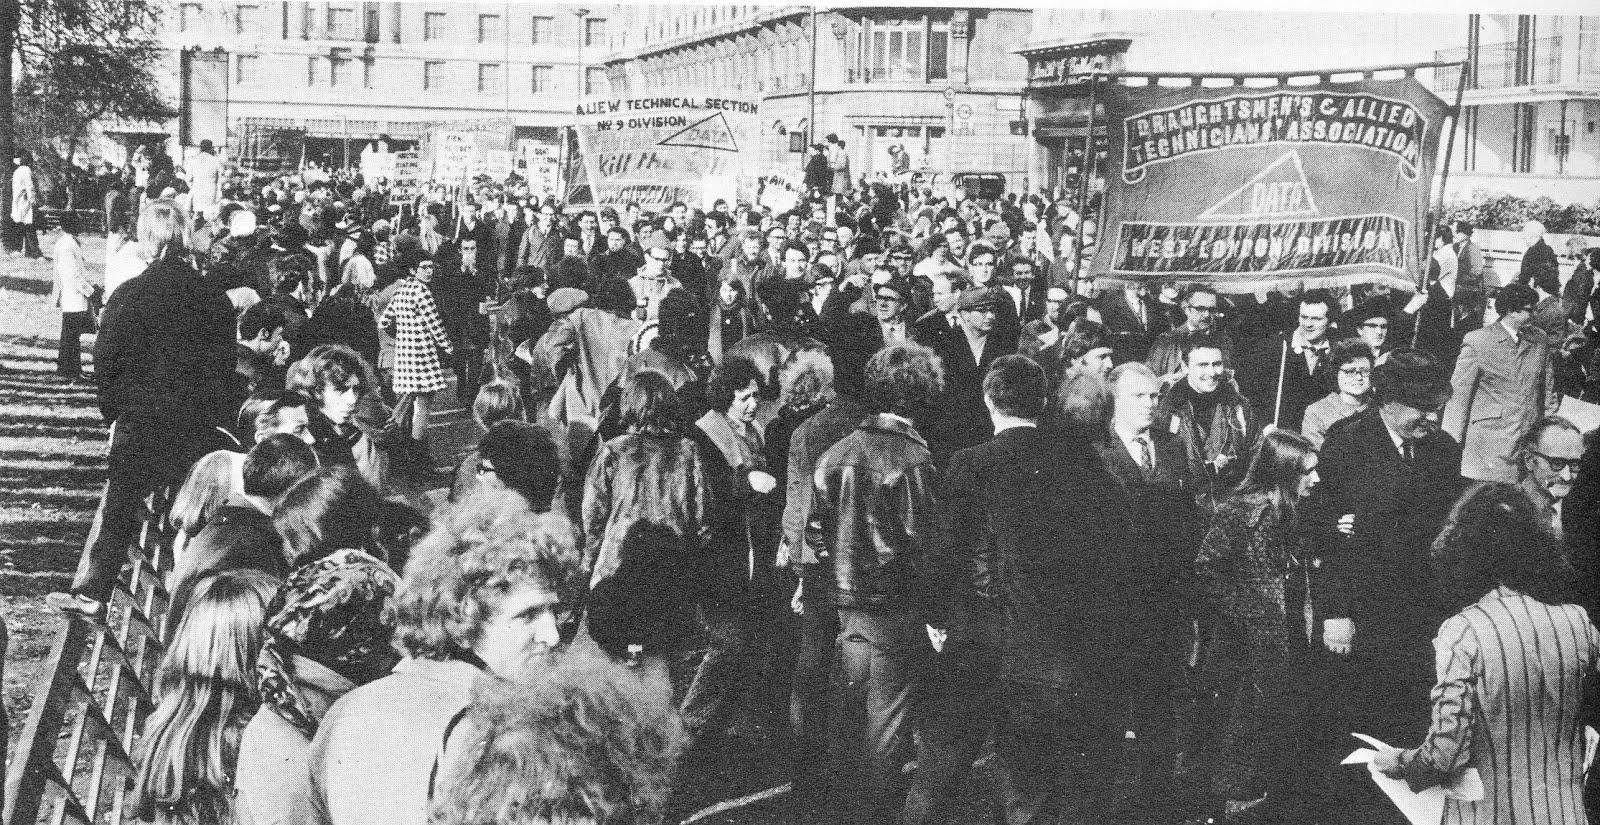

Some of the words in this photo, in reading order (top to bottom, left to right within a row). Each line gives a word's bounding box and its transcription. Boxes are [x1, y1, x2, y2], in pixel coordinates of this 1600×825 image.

[576, 99, 621, 115] AUEW
[627, 98, 698, 109] TECHNICAL
[705, 97, 758, 114] SECTION
[1136, 97, 1313, 135] DRAUGHTSMEN'S
[1320, 98, 1338, 116] &
[1343, 97, 1415, 131] ALLIED
[617, 120, 625, 130] 9
[628, 116, 686, 129] DIVISION
[687, 128, 727, 143] DATA
[1132, 119, 1284, 163] TECHNICIANS'
[1286, 121, 1419, 163] ASSOCIATION
[1252, 182, 1302, 213] DATA
[1131, 238, 1187, 258] WEST
[1198, 236, 1281, 259] LONDON
[1297, 230, 1392, 254] DIVISION
